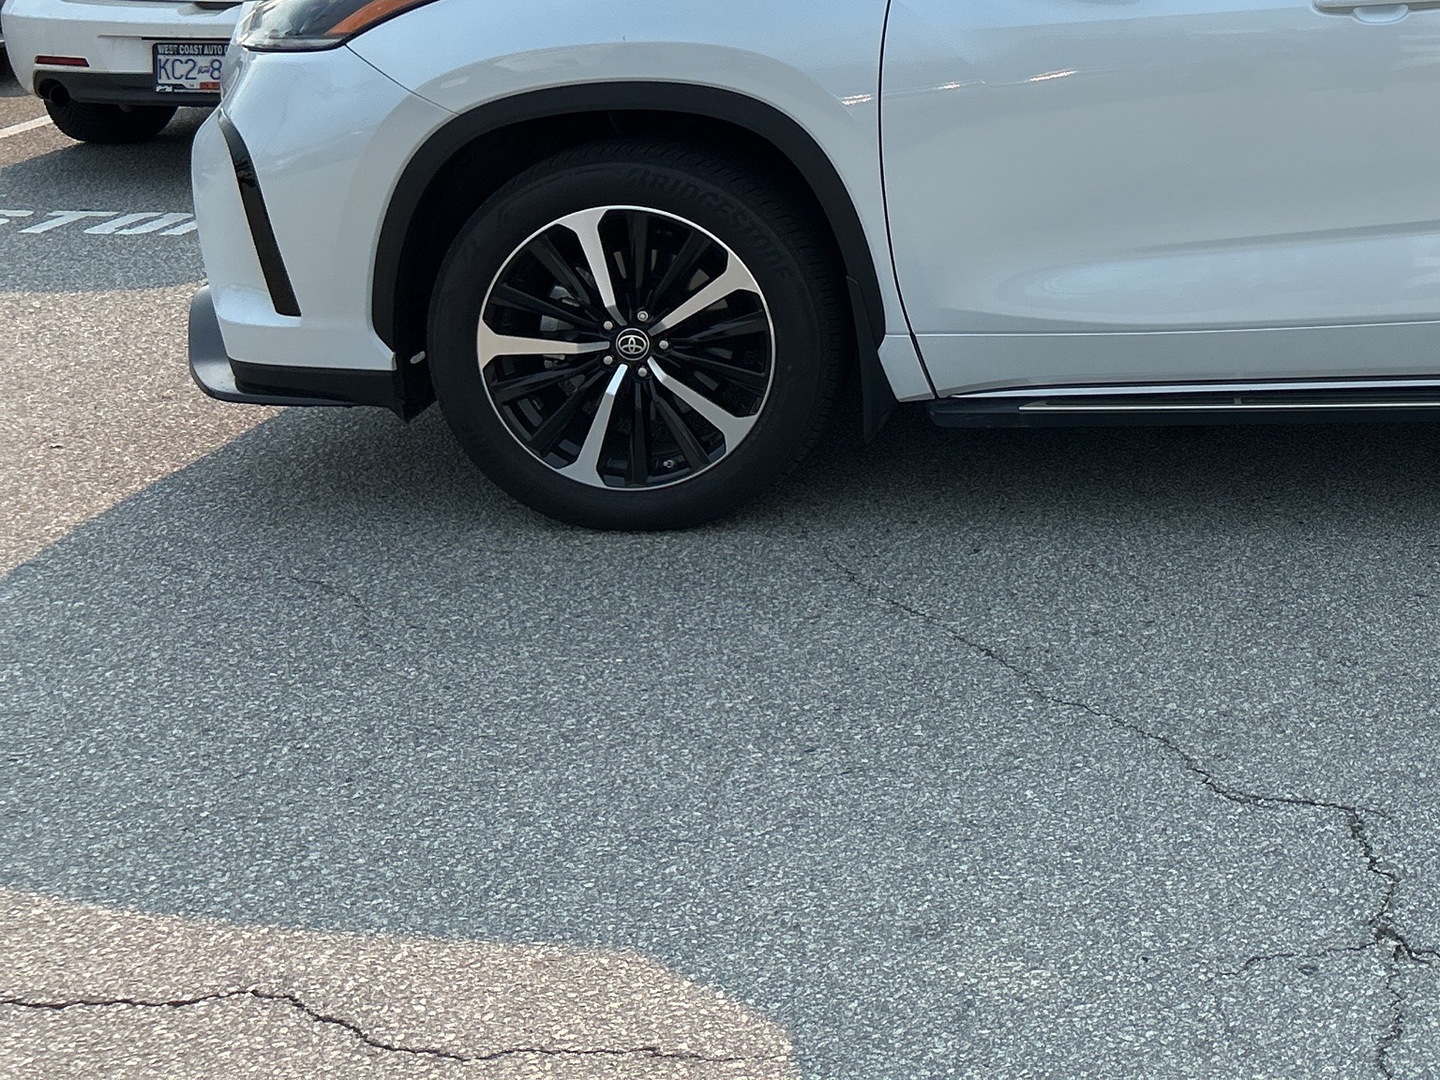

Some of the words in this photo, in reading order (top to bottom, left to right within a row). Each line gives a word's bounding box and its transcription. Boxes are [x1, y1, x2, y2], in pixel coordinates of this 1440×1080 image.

[157, 44, 178, 55] WEST
[179, 44, 202, 55] COAST
[203, 44, 223, 55] AUTO
[158, 58, 197, 81] KC2
